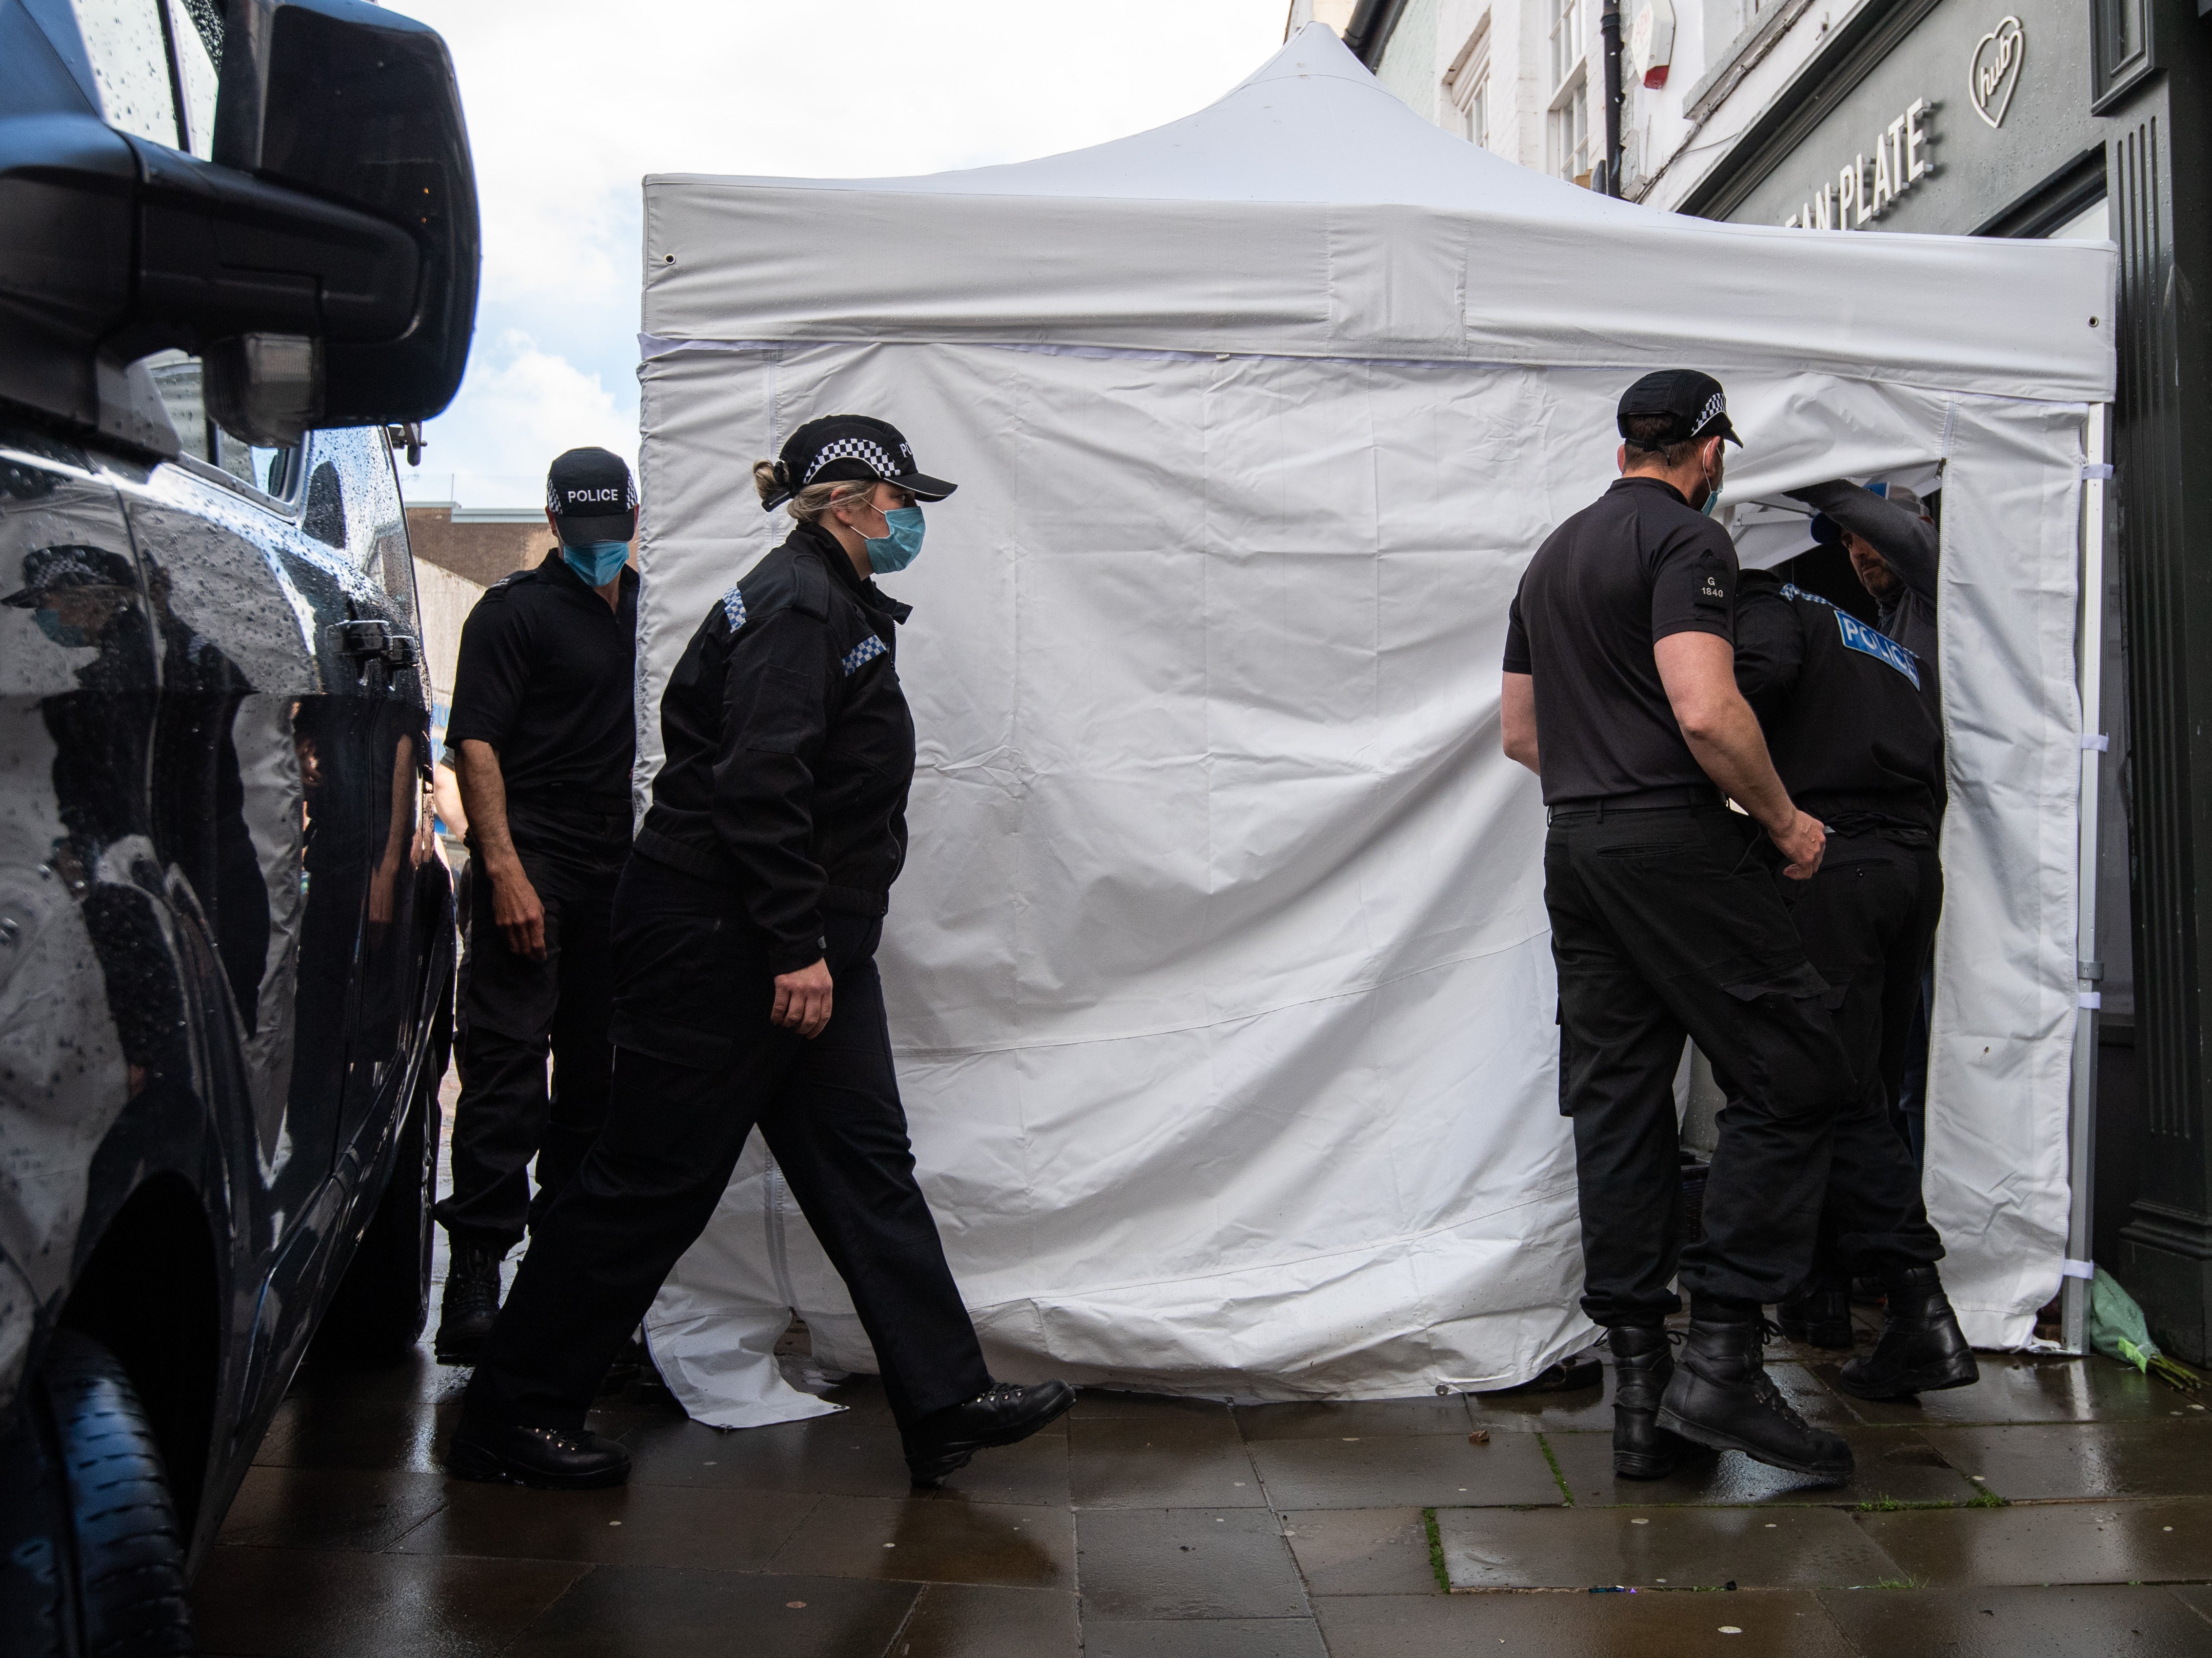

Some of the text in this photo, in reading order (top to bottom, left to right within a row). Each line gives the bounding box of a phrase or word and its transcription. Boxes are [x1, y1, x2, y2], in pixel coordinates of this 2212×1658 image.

[1980, 35, 2012, 108] hub
[1839, 97, 1925, 230] PLATE
[567, 489, 618, 503] POLICE
[1701, 587, 1723, 598] 1840
[1708, 577, 1715, 586] G
[1842, 617, 1919, 682] POLICE
